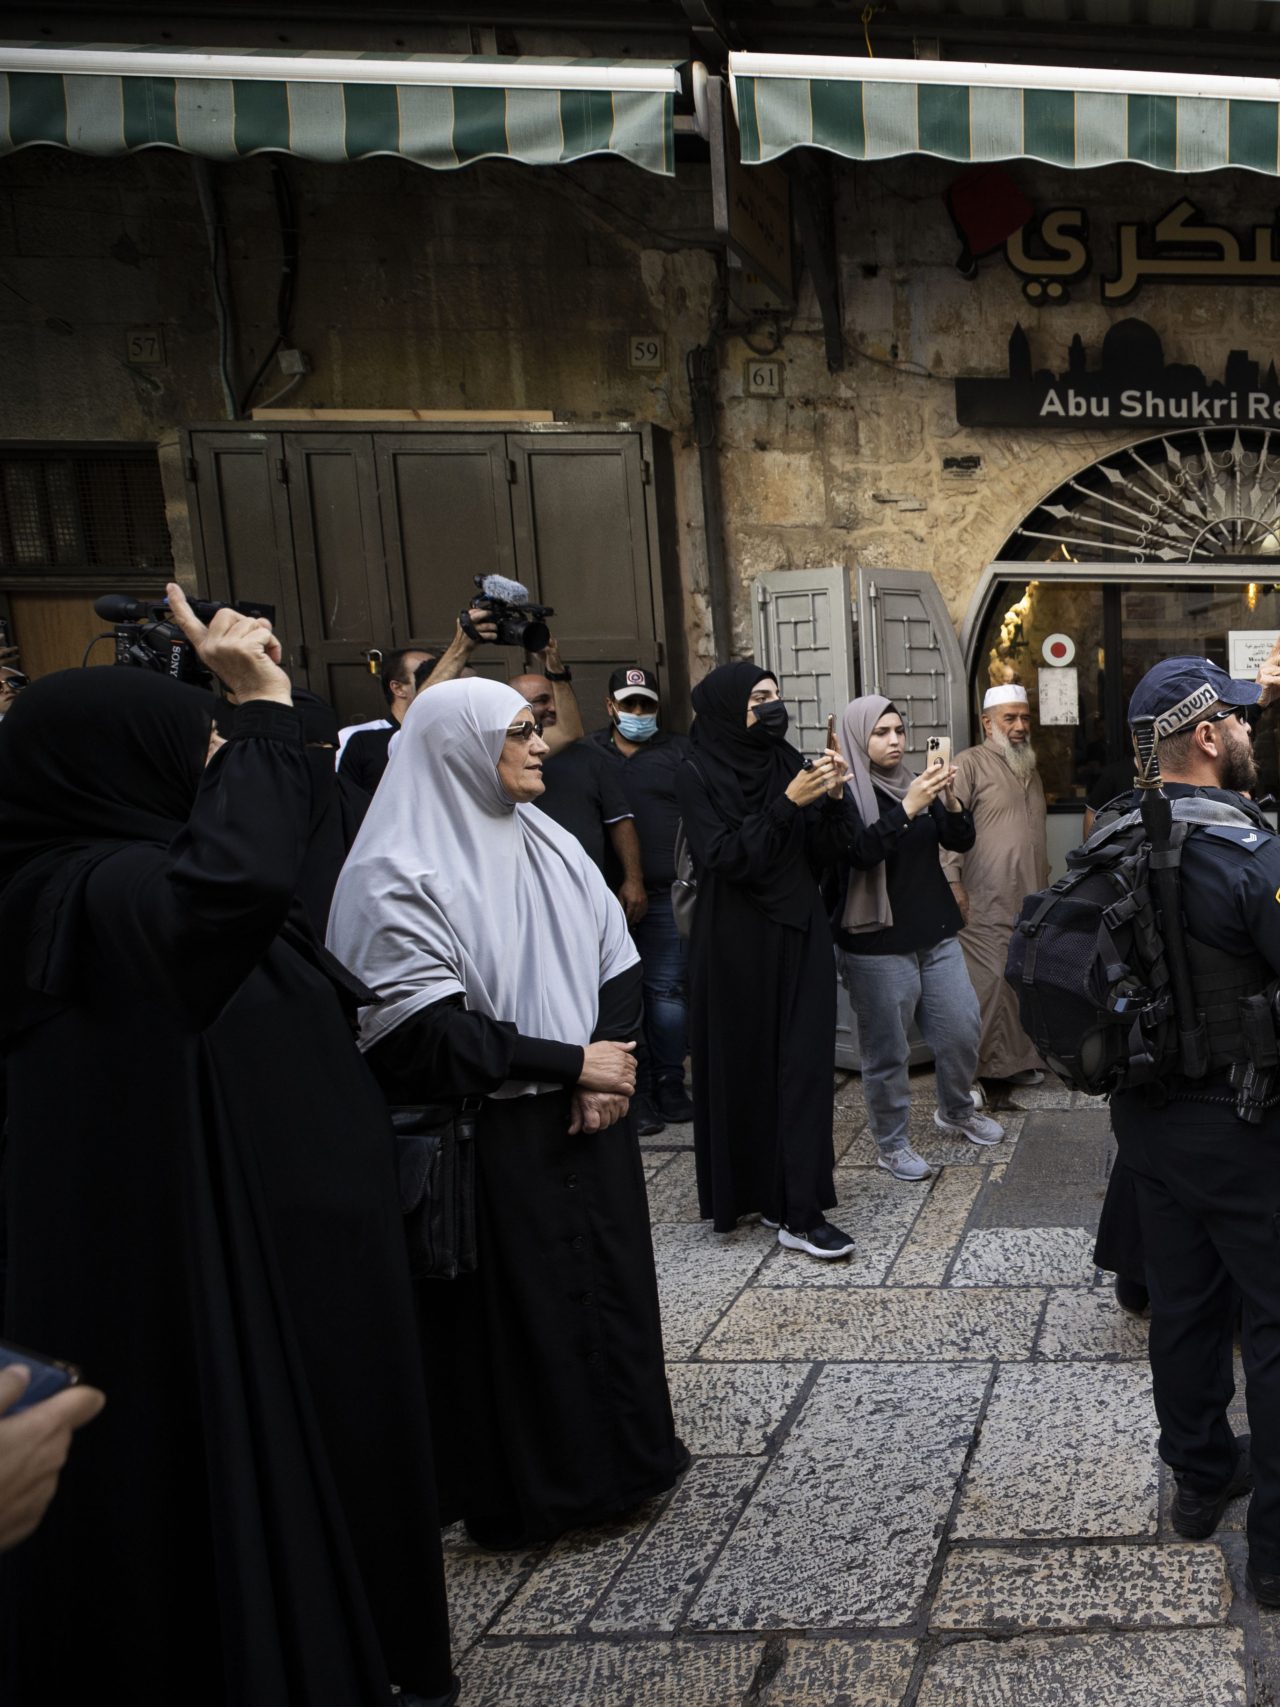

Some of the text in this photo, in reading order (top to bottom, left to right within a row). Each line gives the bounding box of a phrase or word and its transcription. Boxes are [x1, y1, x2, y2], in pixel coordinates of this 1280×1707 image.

[132, 337, 155, 357] 57
[634, 342, 658, 361] 59
[753, 367, 774, 386] 61
[1039, 388, 1110, 417] Abu
[1119, 390, 1238, 419] Shukri
[169, 645, 181, 678] SONY
[1158, 688, 1215, 733] משטרה
